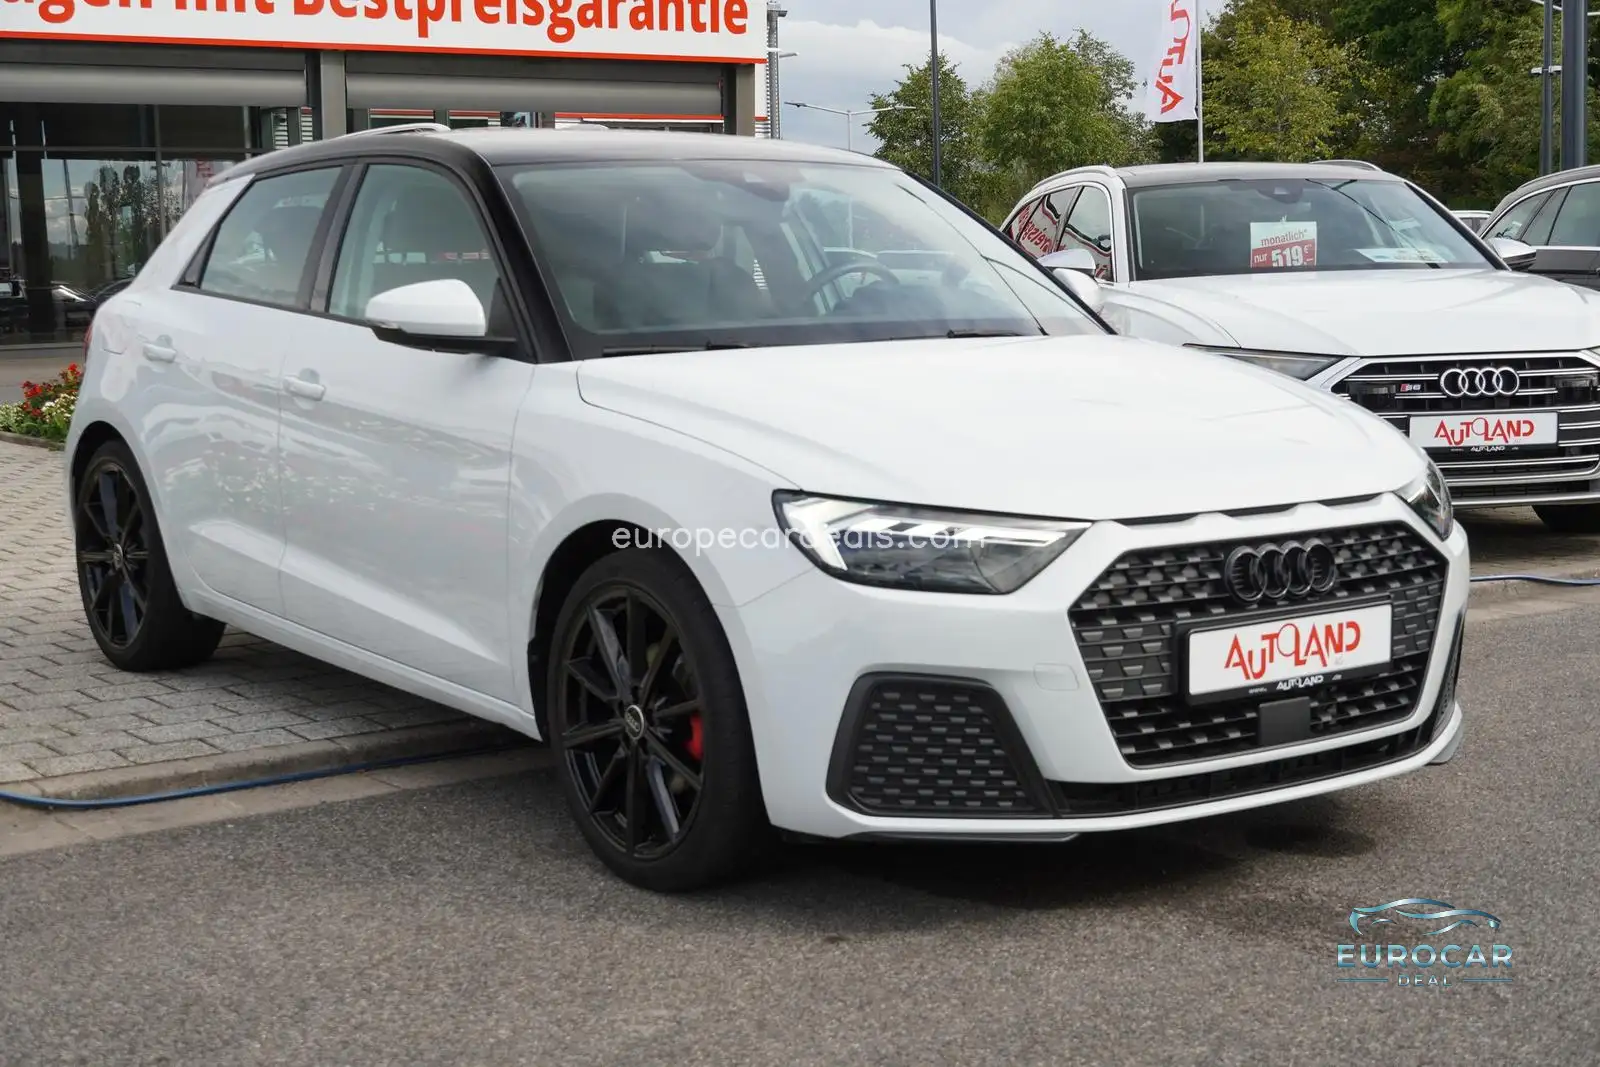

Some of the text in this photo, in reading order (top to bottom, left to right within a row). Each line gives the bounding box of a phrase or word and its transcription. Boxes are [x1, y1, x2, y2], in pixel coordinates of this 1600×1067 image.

[1254, 254, 1268, 264] nur
[1434, 417, 1535, 446] AUTOLAND
[1224, 621, 1361, 680] AUTOLAND
